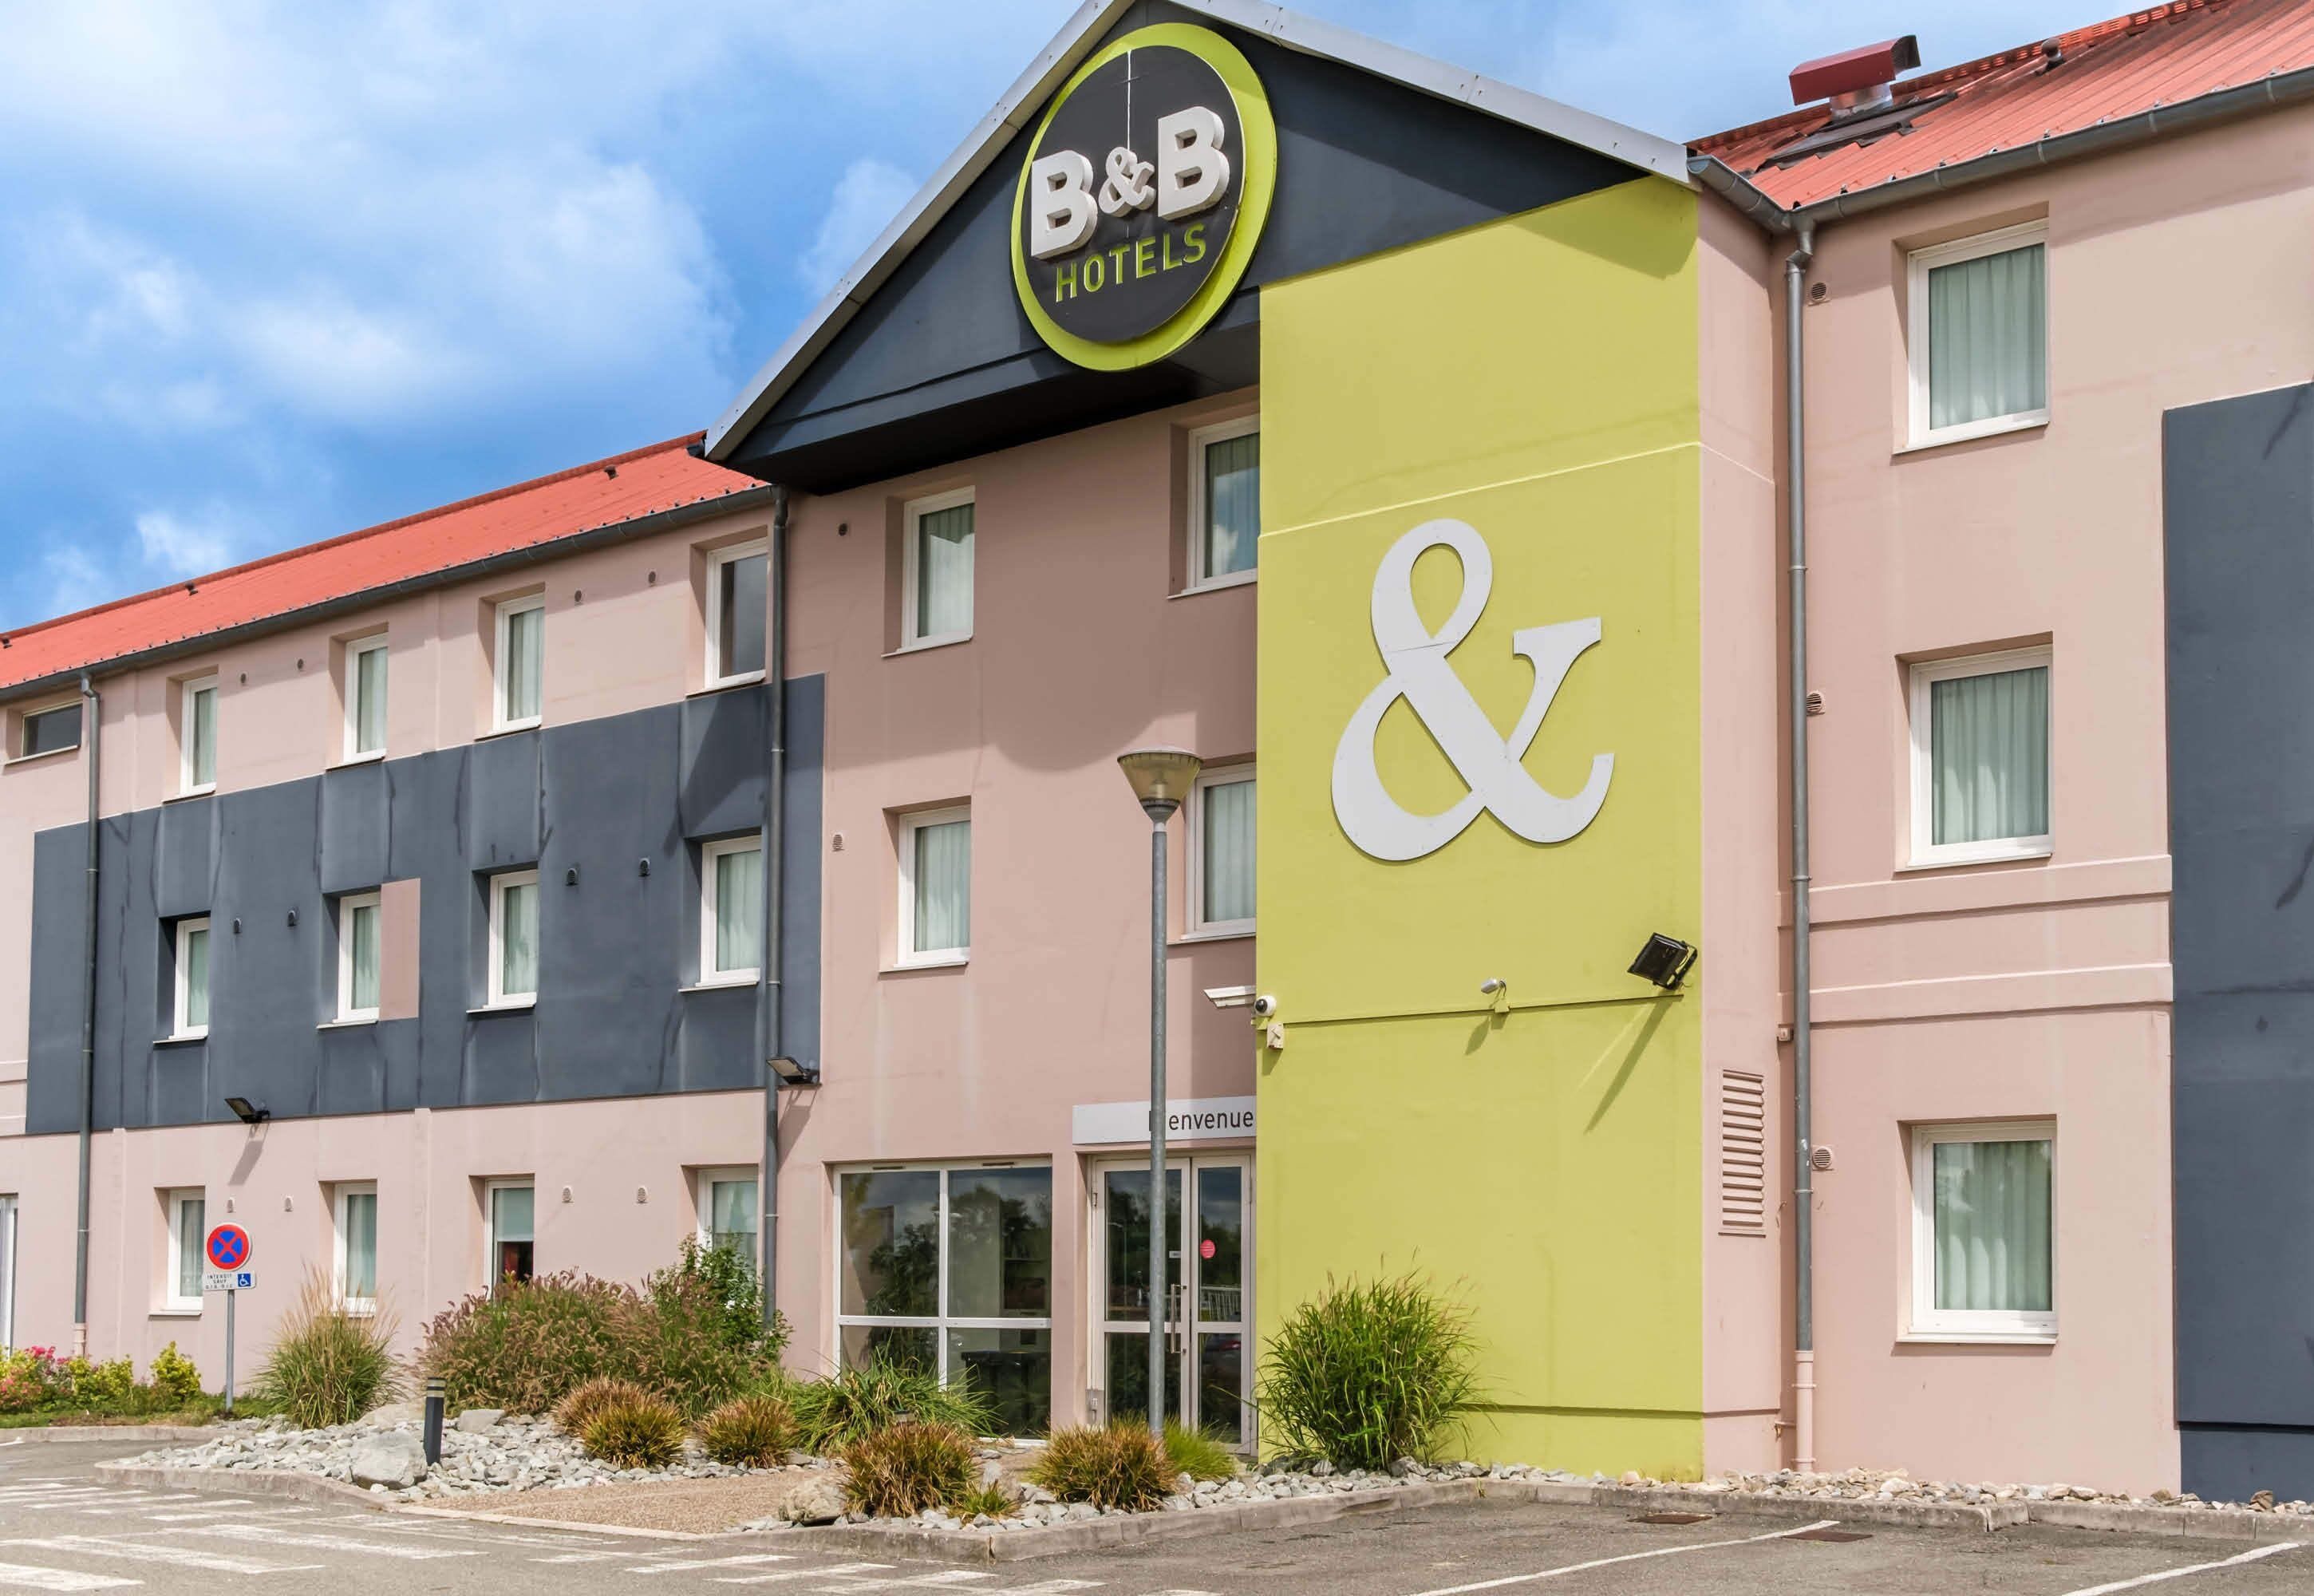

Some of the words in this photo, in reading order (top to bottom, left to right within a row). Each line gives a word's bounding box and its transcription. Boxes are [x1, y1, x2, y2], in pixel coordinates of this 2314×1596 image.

[1031, 106, 1230, 259] B&B
[1056, 223, 1207, 302] HOTELS
[1331, 518, 1615, 862] &
[1149, 1110, 1254, 1132] envenue
